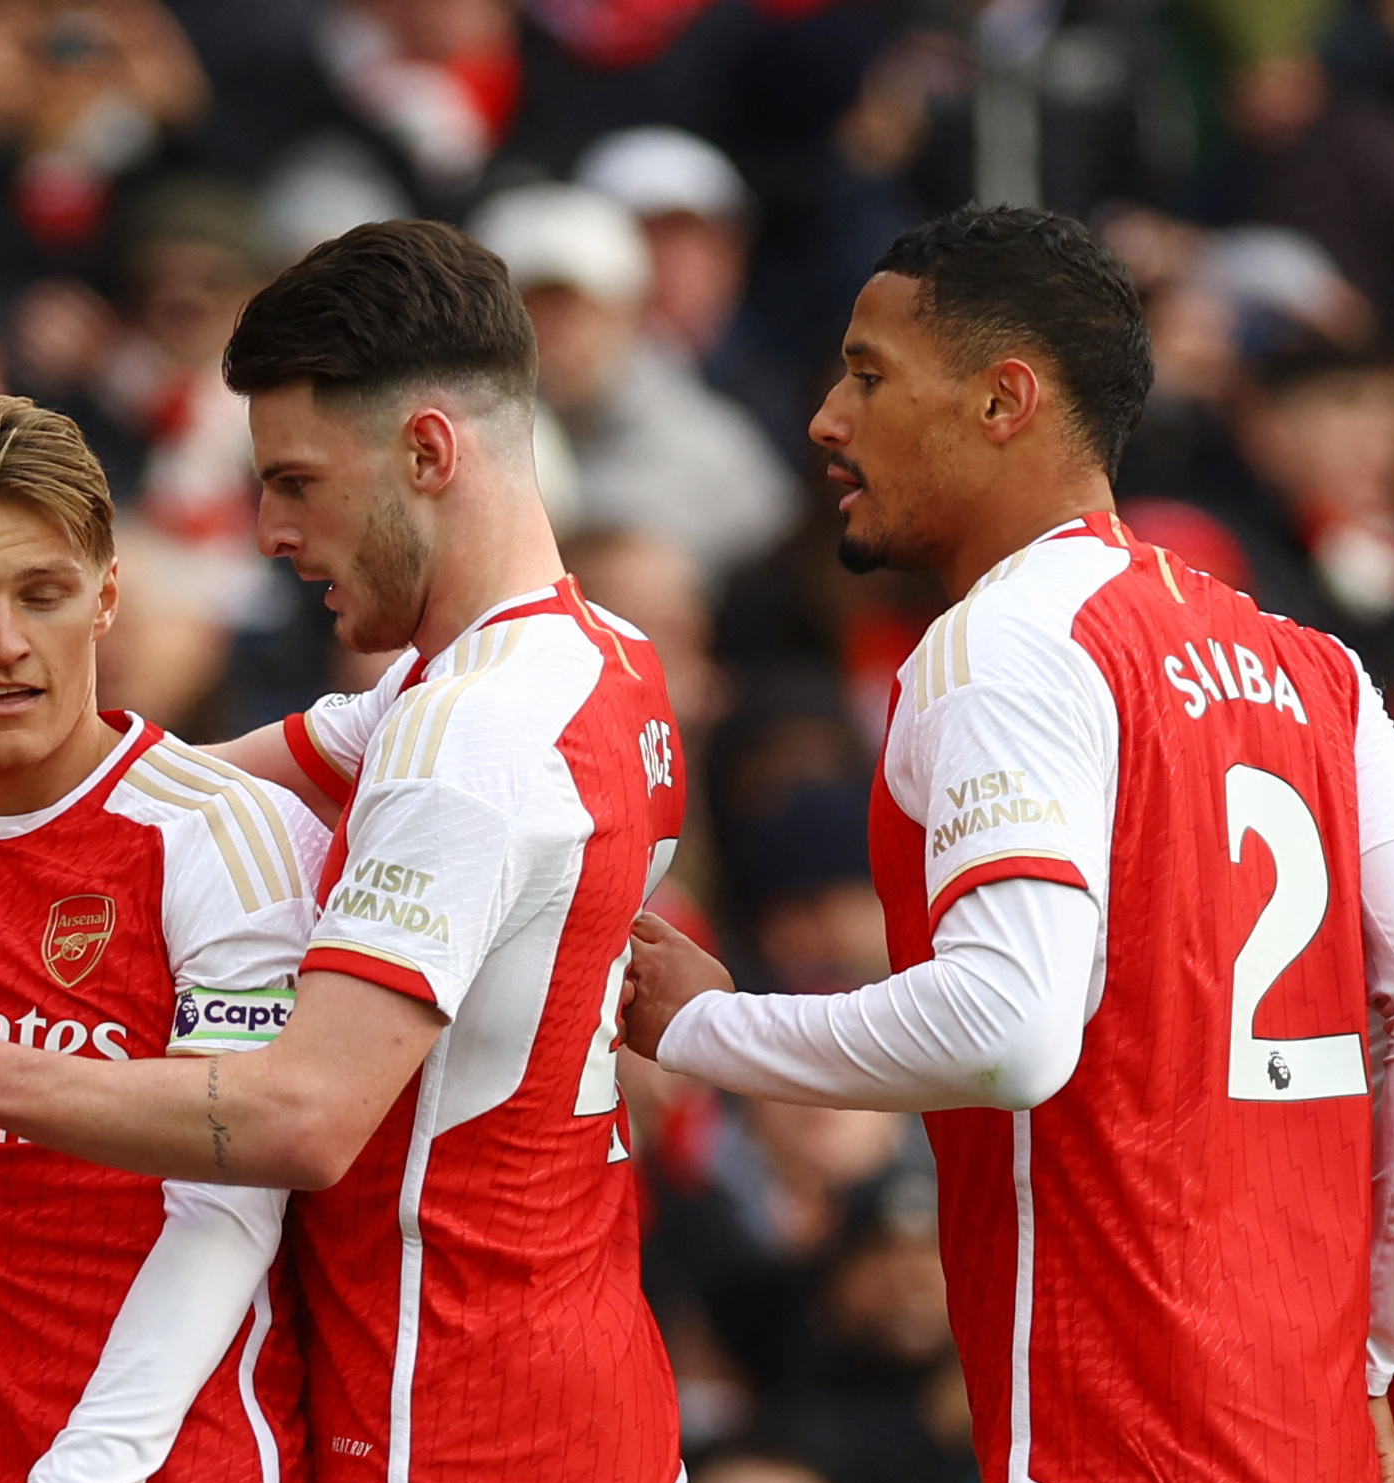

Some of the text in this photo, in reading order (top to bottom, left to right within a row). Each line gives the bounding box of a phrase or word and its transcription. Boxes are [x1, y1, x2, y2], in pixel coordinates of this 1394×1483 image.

[945, 769, 1027, 810] VISIT
[933, 798, 1068, 859] RWANDA
[353, 857, 435, 899] VISIT
[57, 910, 106, 928] Arsenal
[329, 886, 449, 945] WANDA
[1224, 762, 1370, 1103] 2
[203, 999, 294, 1031] Capt
